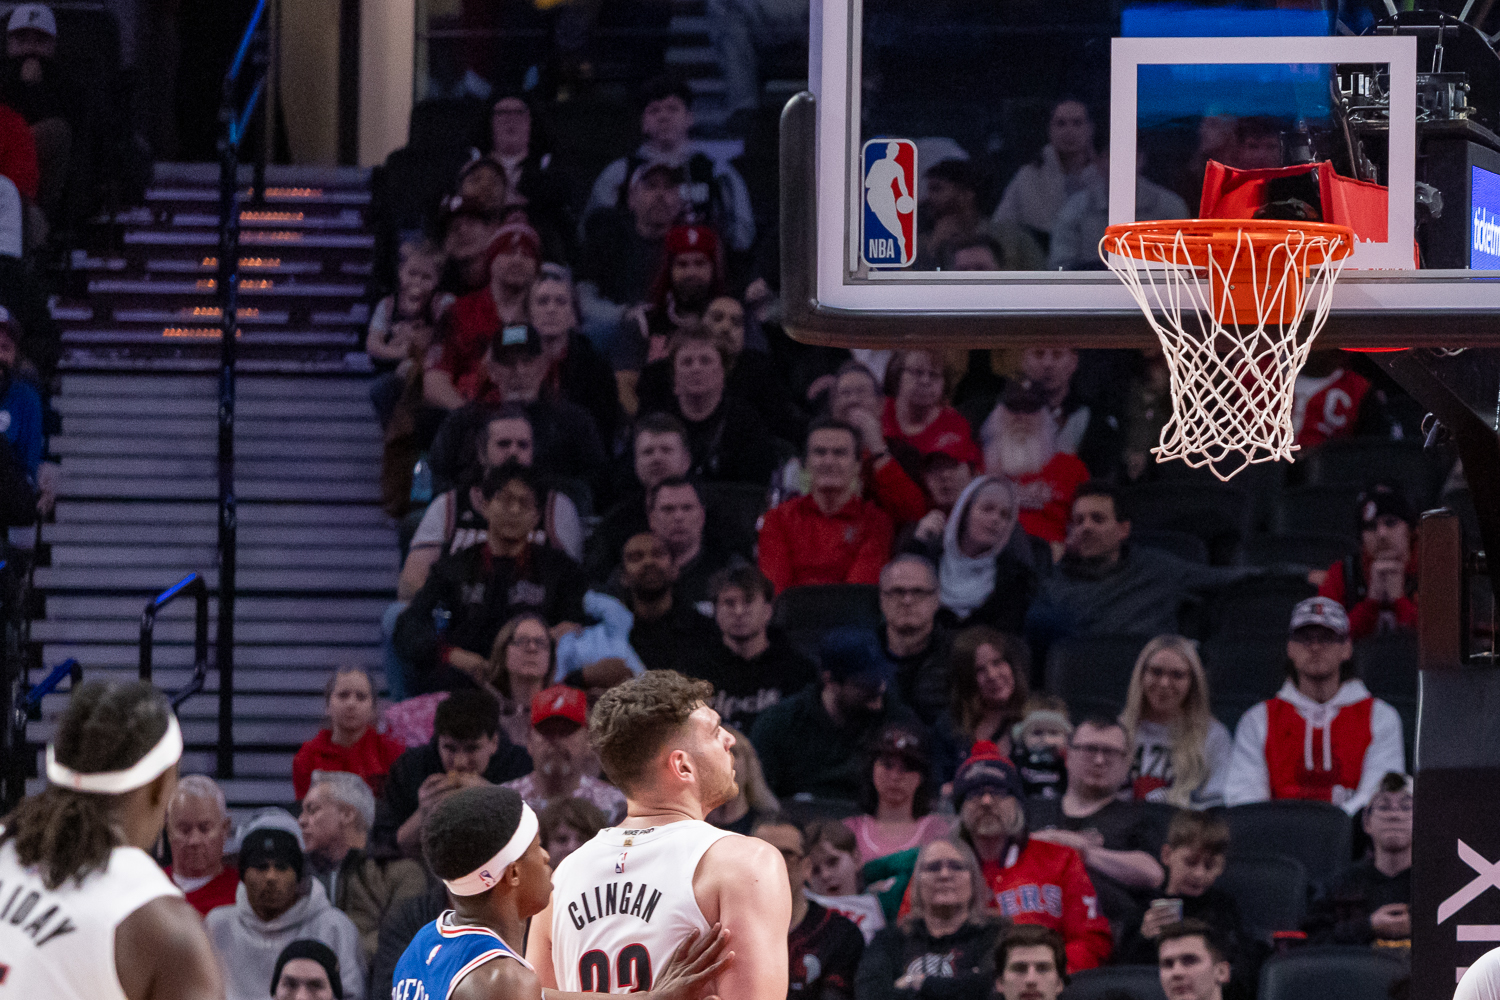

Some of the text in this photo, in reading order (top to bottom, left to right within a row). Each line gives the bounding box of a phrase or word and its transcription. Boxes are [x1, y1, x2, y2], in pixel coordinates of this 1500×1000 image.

[869, 238, 896, 259] NBA
[0, 880, 77, 947] IDAY
[567, 881, 663, 932] CLINGAN
